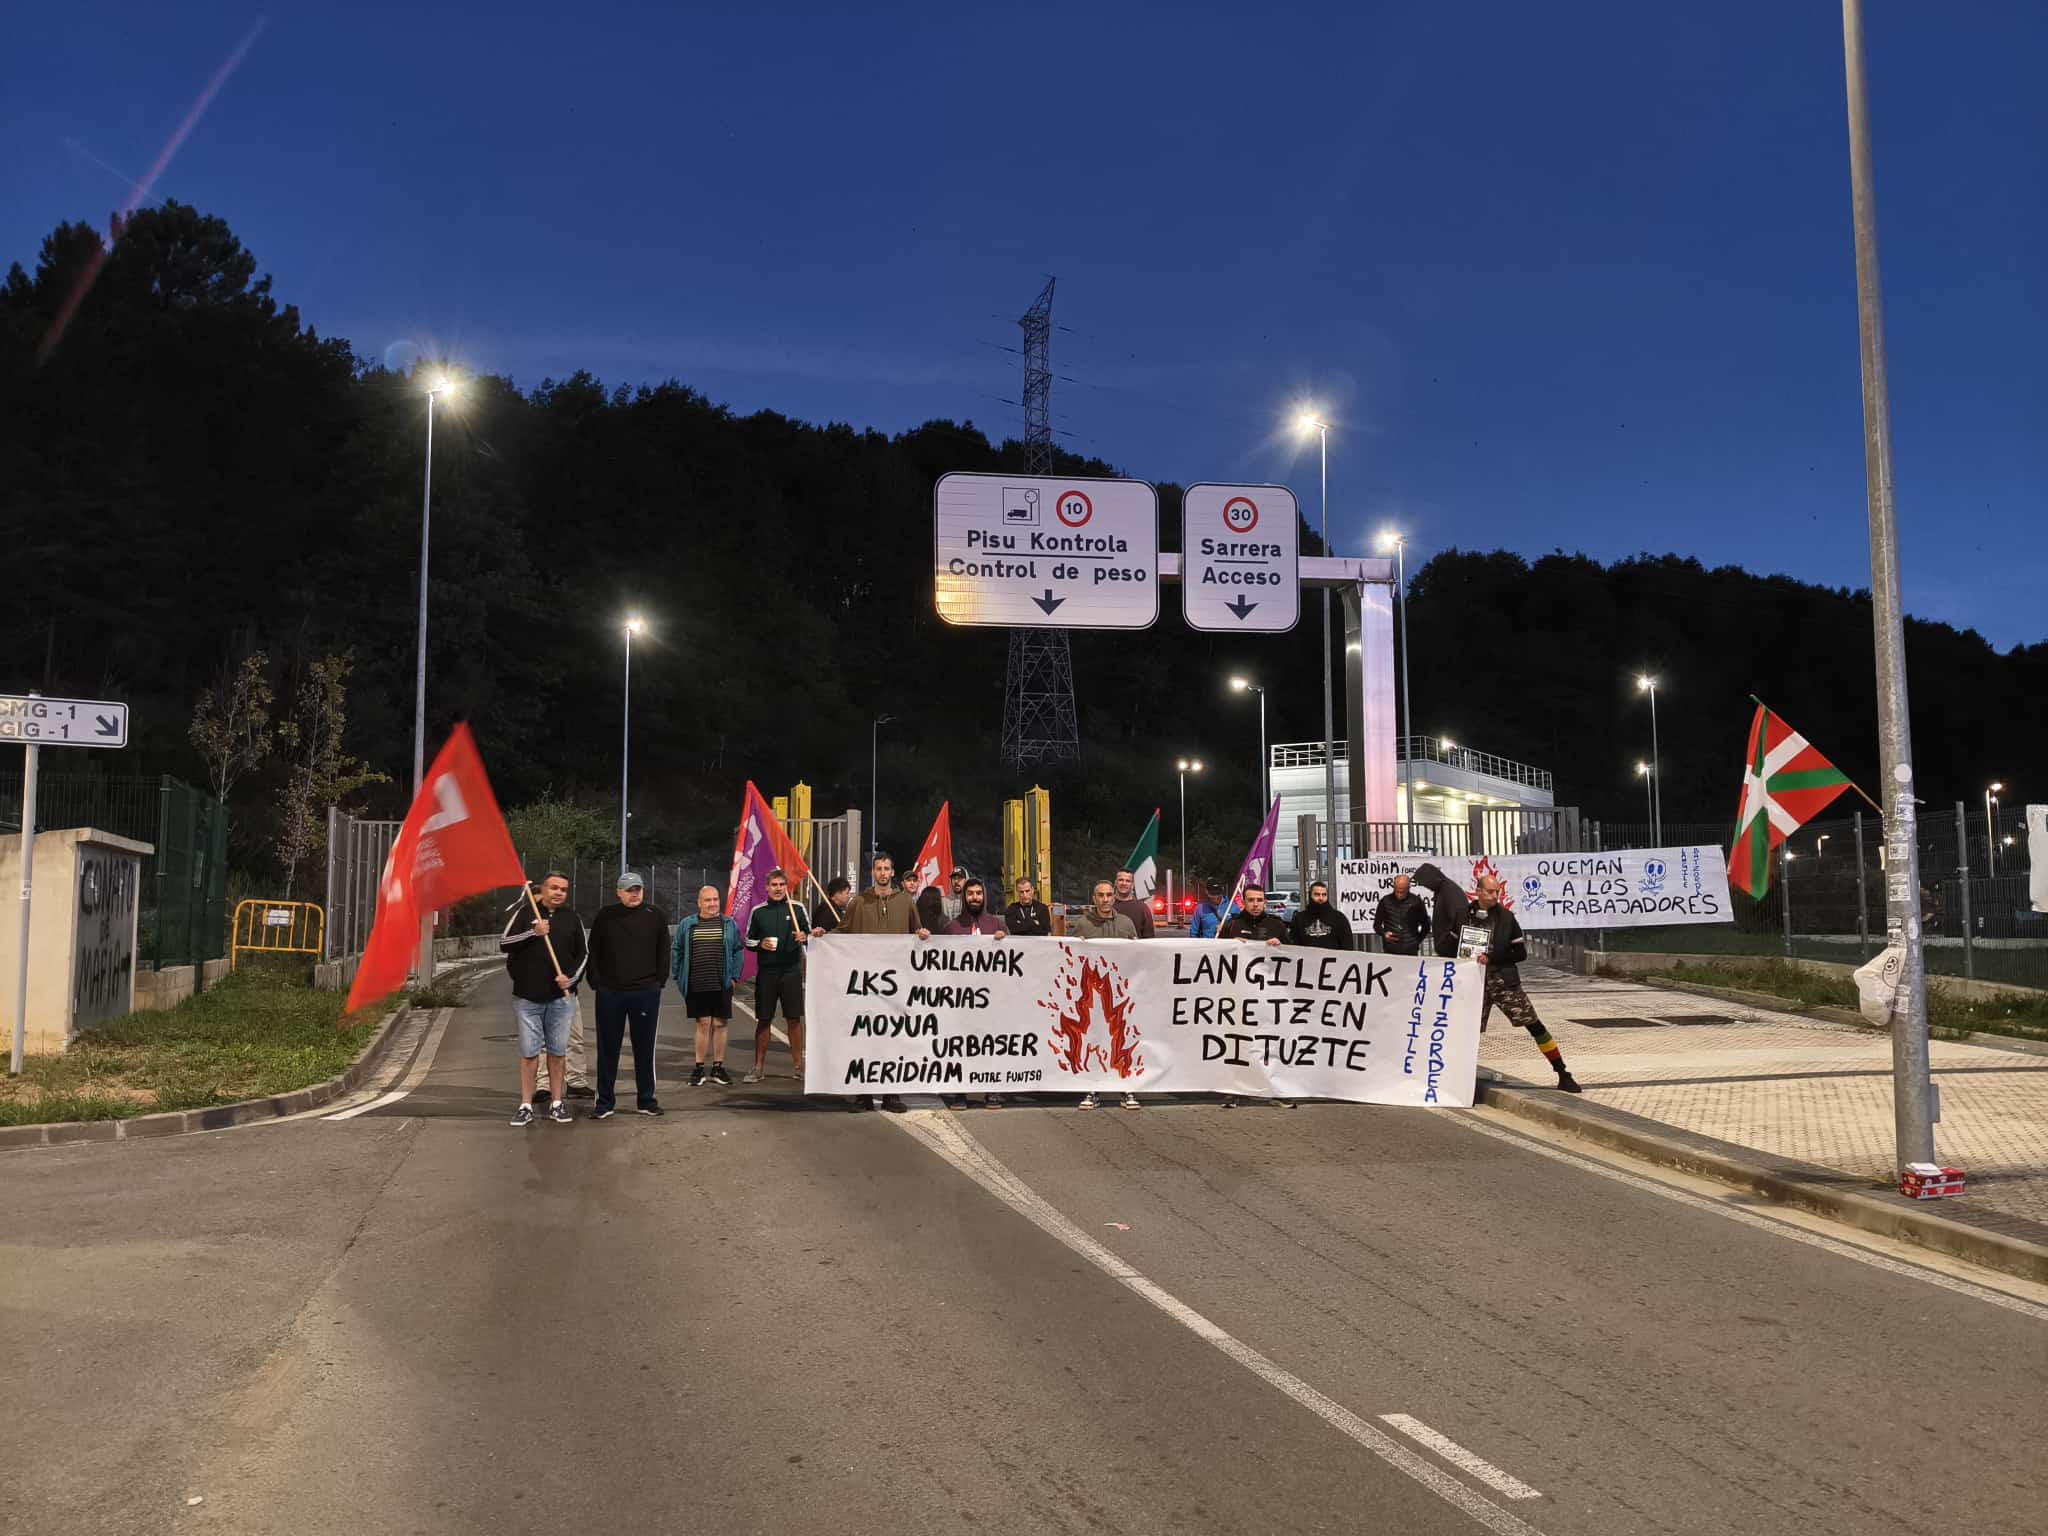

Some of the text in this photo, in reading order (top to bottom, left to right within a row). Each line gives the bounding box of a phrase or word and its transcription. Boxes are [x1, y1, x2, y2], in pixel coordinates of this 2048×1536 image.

[1065, 502, 1083, 515] 10
[1231, 509, 1251, 521] 30
[967, 530, 1128, 553] Pisu Kontrola
[1200, 538, 1282, 557] Sarrera
[949, 558, 1147, 585] Control de peso
[1202, 566, 1281, 585] Acceso
[1537, 857, 1623, 876] QUEMAN
[1340, 891, 1380, 903] MOYUA
[1562, 878, 1629, 896] A LOS
[1352, 908, 1377, 921] LKS
[1547, 894, 1719, 916] TRABAJADORES
[910, 948, 1025, 977] URILANAK
[846, 969, 899, 997] LKS
[1172, 953, 1392, 997] LANGILEAK
[907, 985, 990, 1009] MURIAS
[850, 1013, 939, 1038] MOYUA
[1172, 997, 1367, 1031] ERRETZEN
[1404, 960, 1428, 1074] LANGILE
[1424, 961, 1457, 1103] BATZORDEA
[932, 1032, 1039, 1058] URBASER
[1202, 1034, 1371, 1071] DITUZTE
[969, 1071, 1001, 1084] PUTRE
